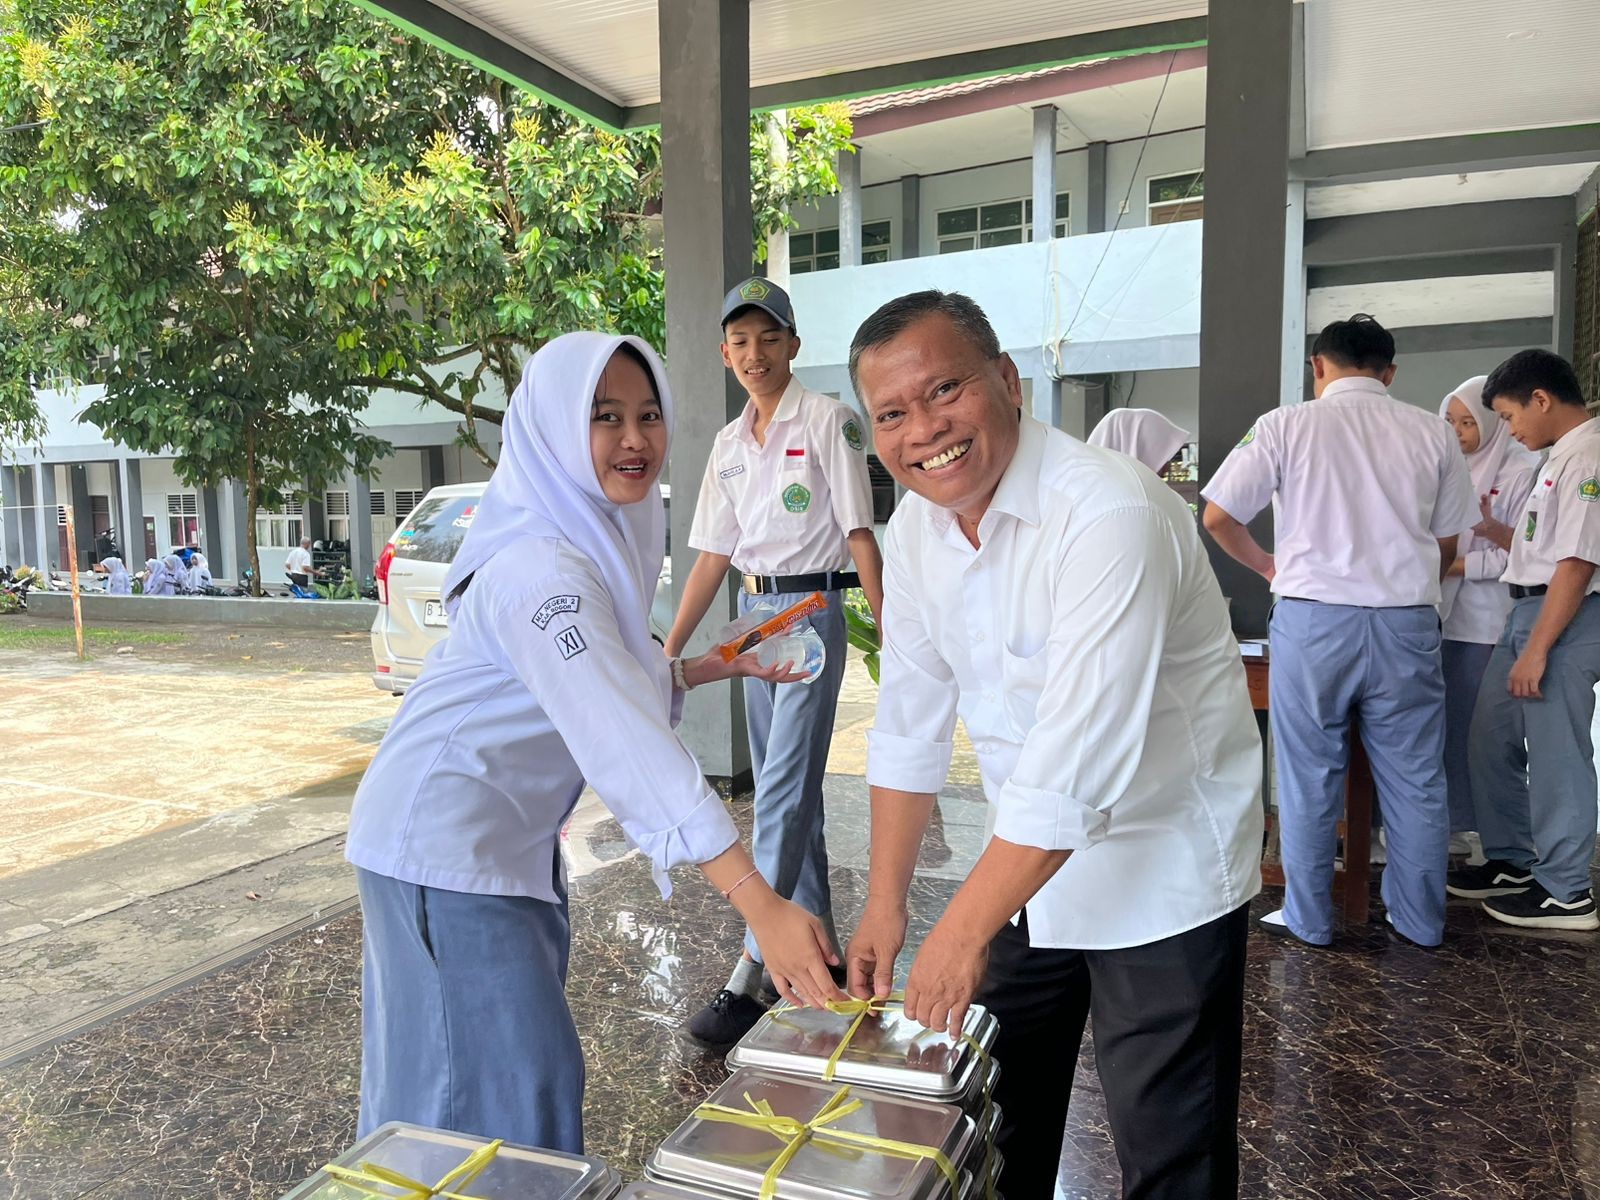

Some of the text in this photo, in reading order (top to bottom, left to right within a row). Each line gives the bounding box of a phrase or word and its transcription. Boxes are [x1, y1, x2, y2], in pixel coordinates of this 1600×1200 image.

[427, 604, 432, 615] B
[544, 598, 567, 612] NEGERI
[550, 604, 572, 612] BOGOR
[559, 631, 579, 654] XI
